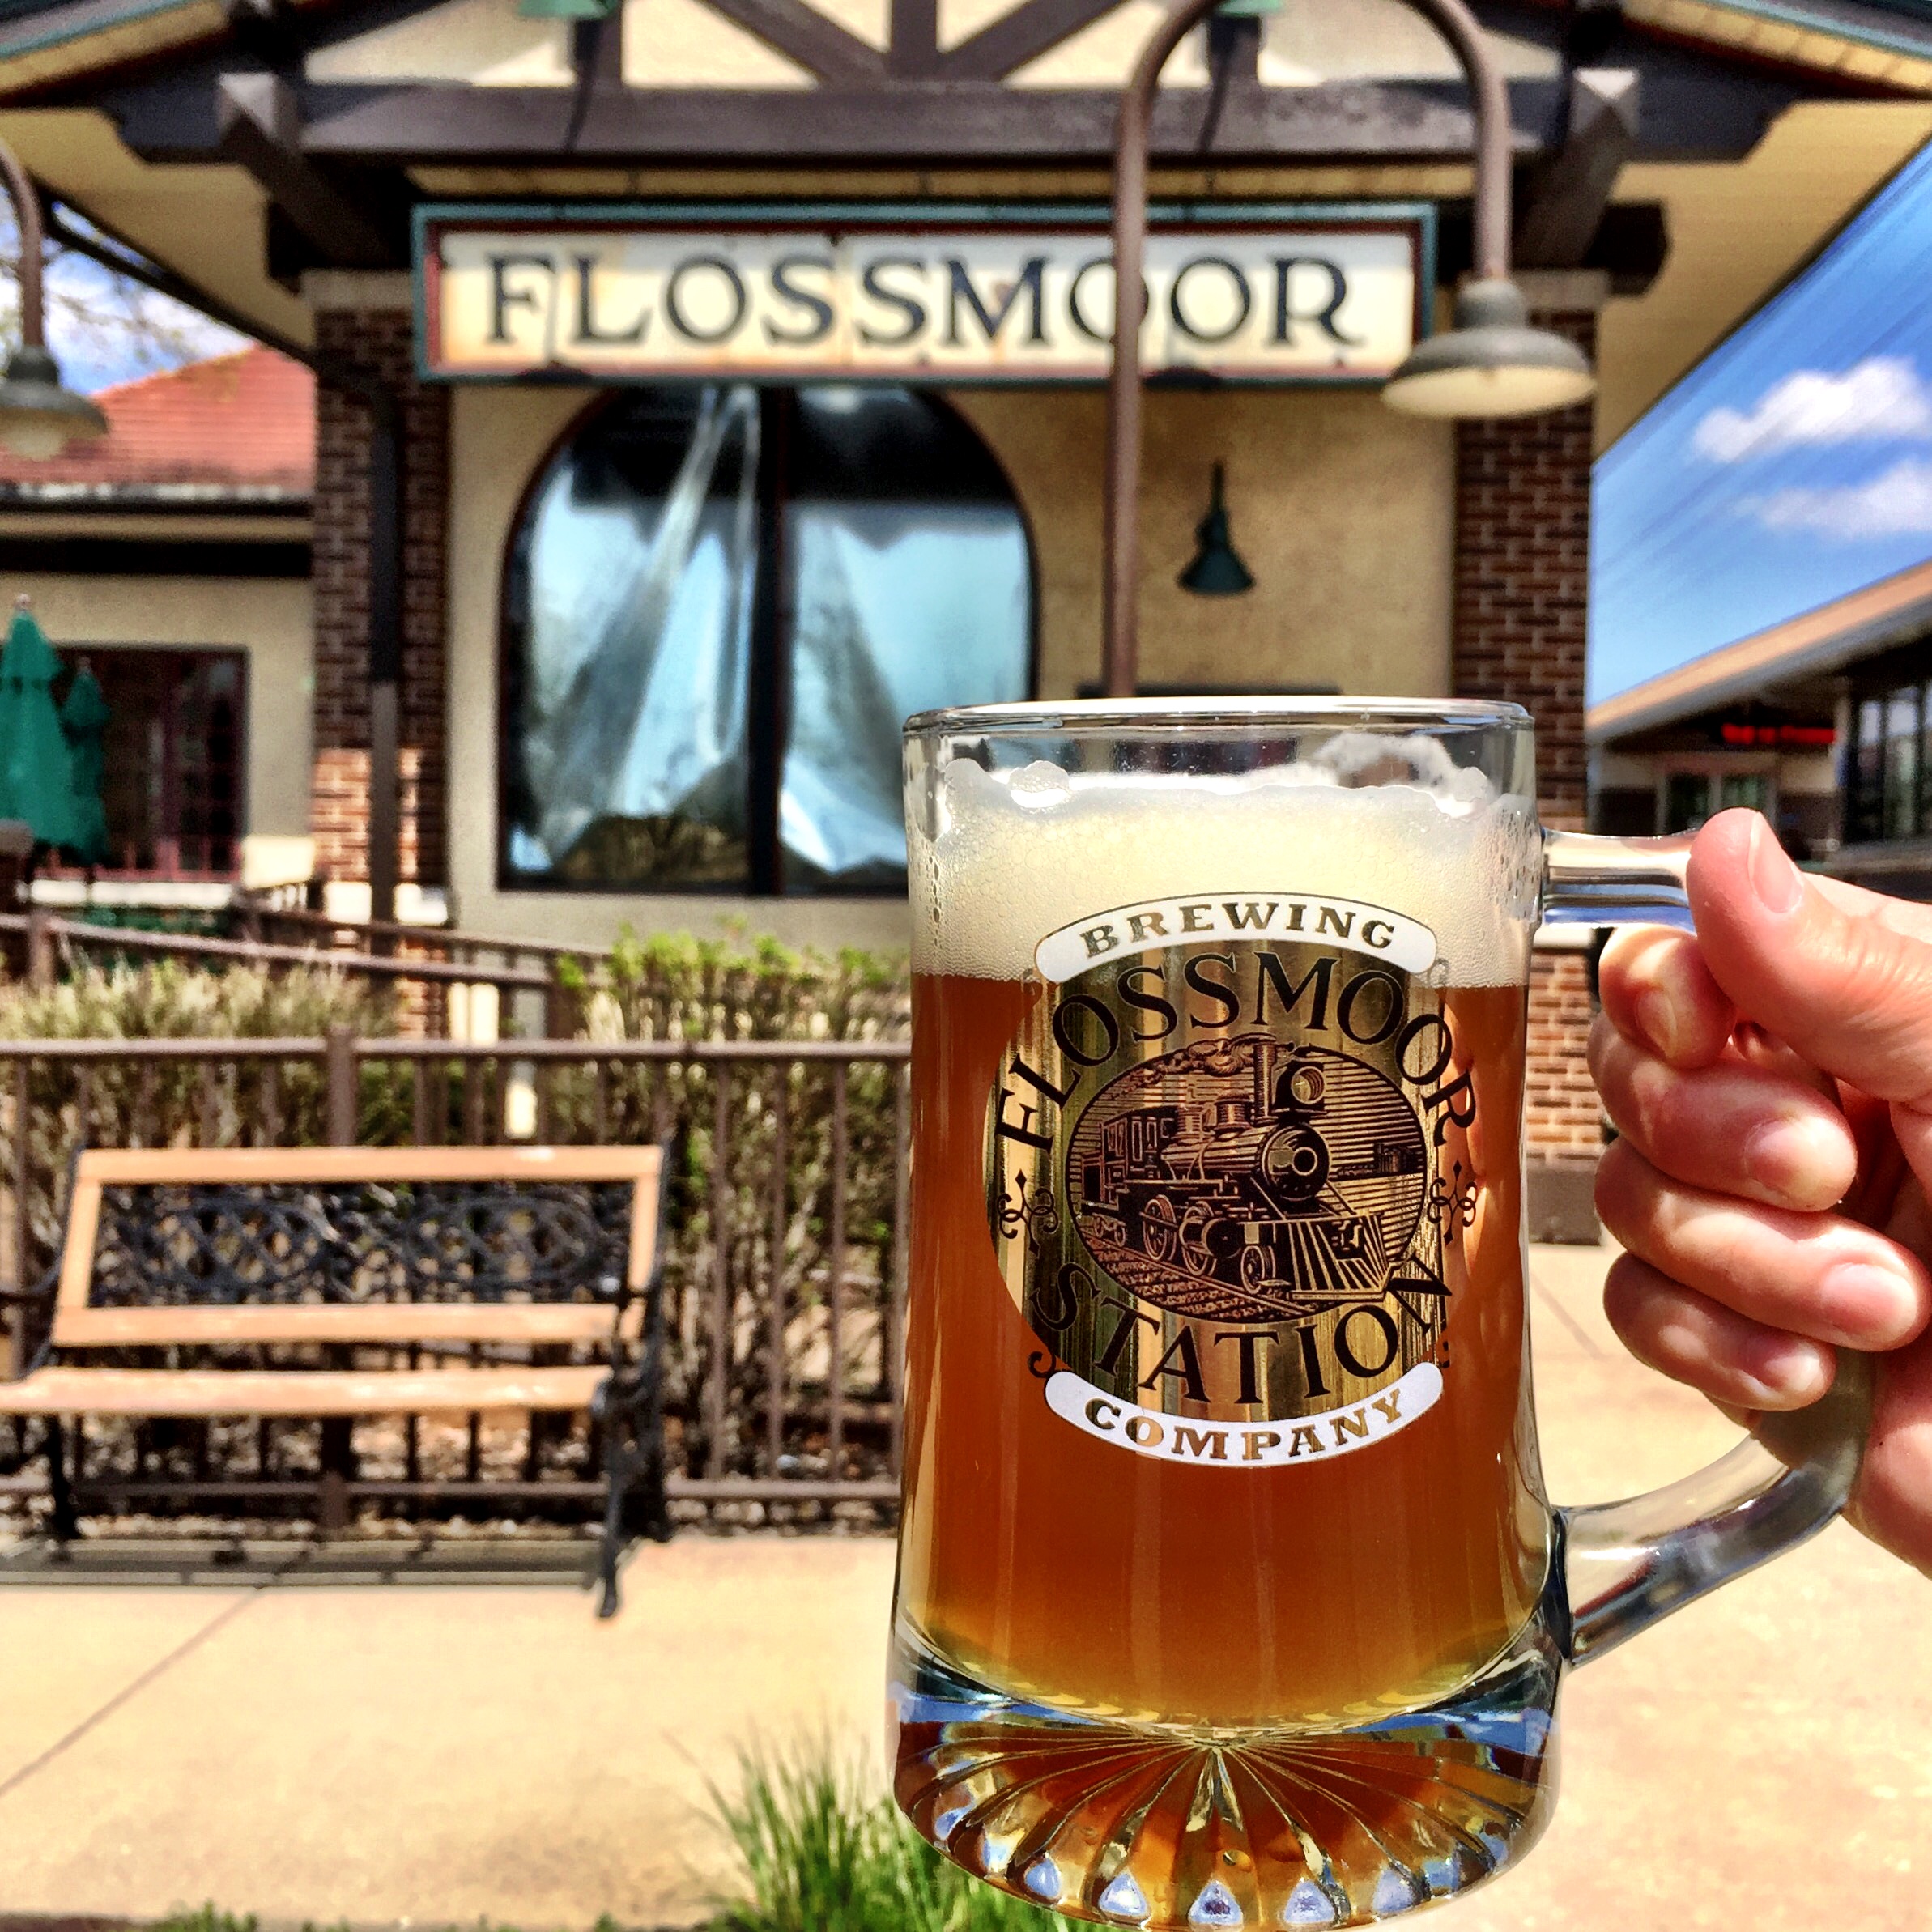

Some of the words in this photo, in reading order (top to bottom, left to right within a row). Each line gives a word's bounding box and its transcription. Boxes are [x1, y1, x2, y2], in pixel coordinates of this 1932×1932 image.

[487, 254, 1364, 347] FLOSSMOOR
[1079, 902, 1397, 959] BREWING
[995, 951, 1476, 1152] FLOSSMOOR
[1029, 1253, 1453, 1404] STATION
[1084, 1389, 1402, 1461] COMPANY
